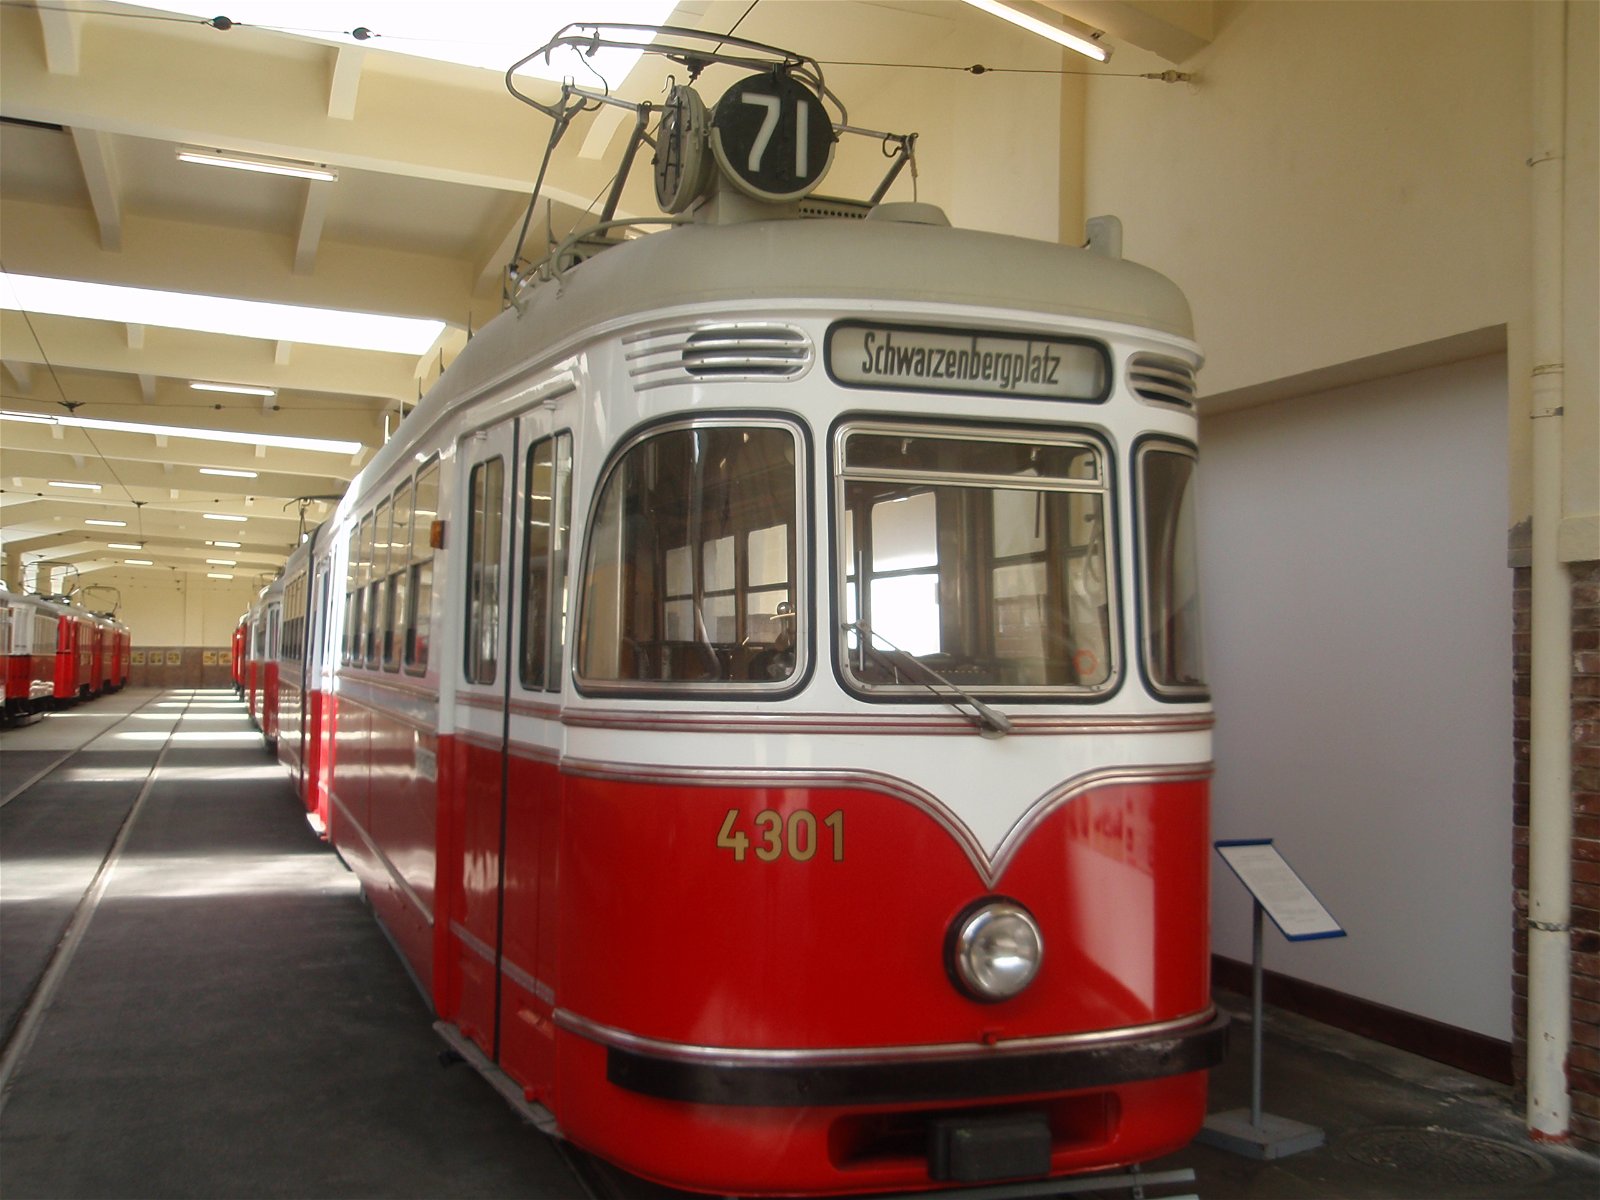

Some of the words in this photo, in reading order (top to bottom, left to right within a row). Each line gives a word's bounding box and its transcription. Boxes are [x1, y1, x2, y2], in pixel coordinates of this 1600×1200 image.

[741, 92, 809, 178] 71
[862, 331, 1062, 389] Schwarzenbergplatz
[716, 808, 844, 862] 4301
